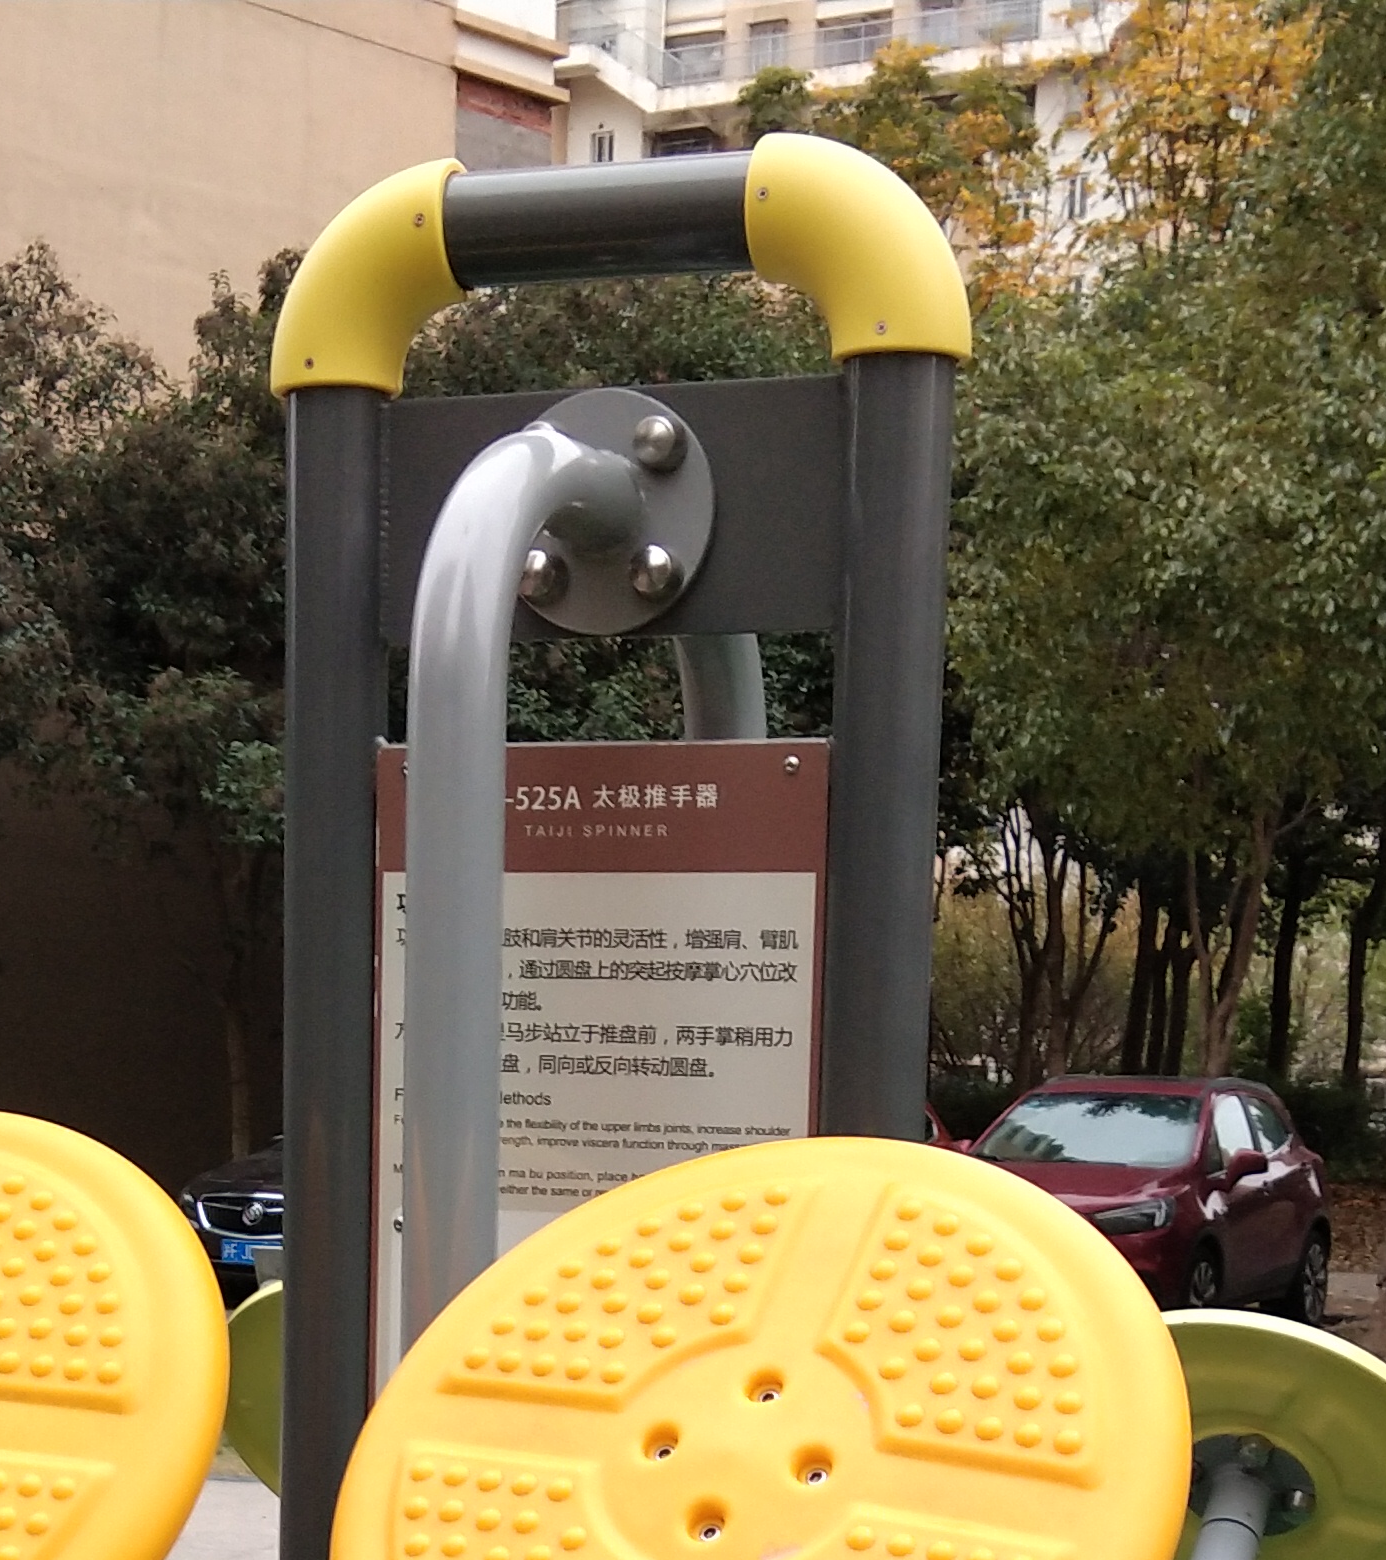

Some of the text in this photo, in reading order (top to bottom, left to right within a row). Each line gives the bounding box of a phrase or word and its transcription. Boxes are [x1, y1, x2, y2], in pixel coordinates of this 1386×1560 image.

[592, 784, 719, 809] 太极推手器
[524, 823, 669, 838] TAIJI SPINNER
[500, 1091, 552, 1106] ethods
